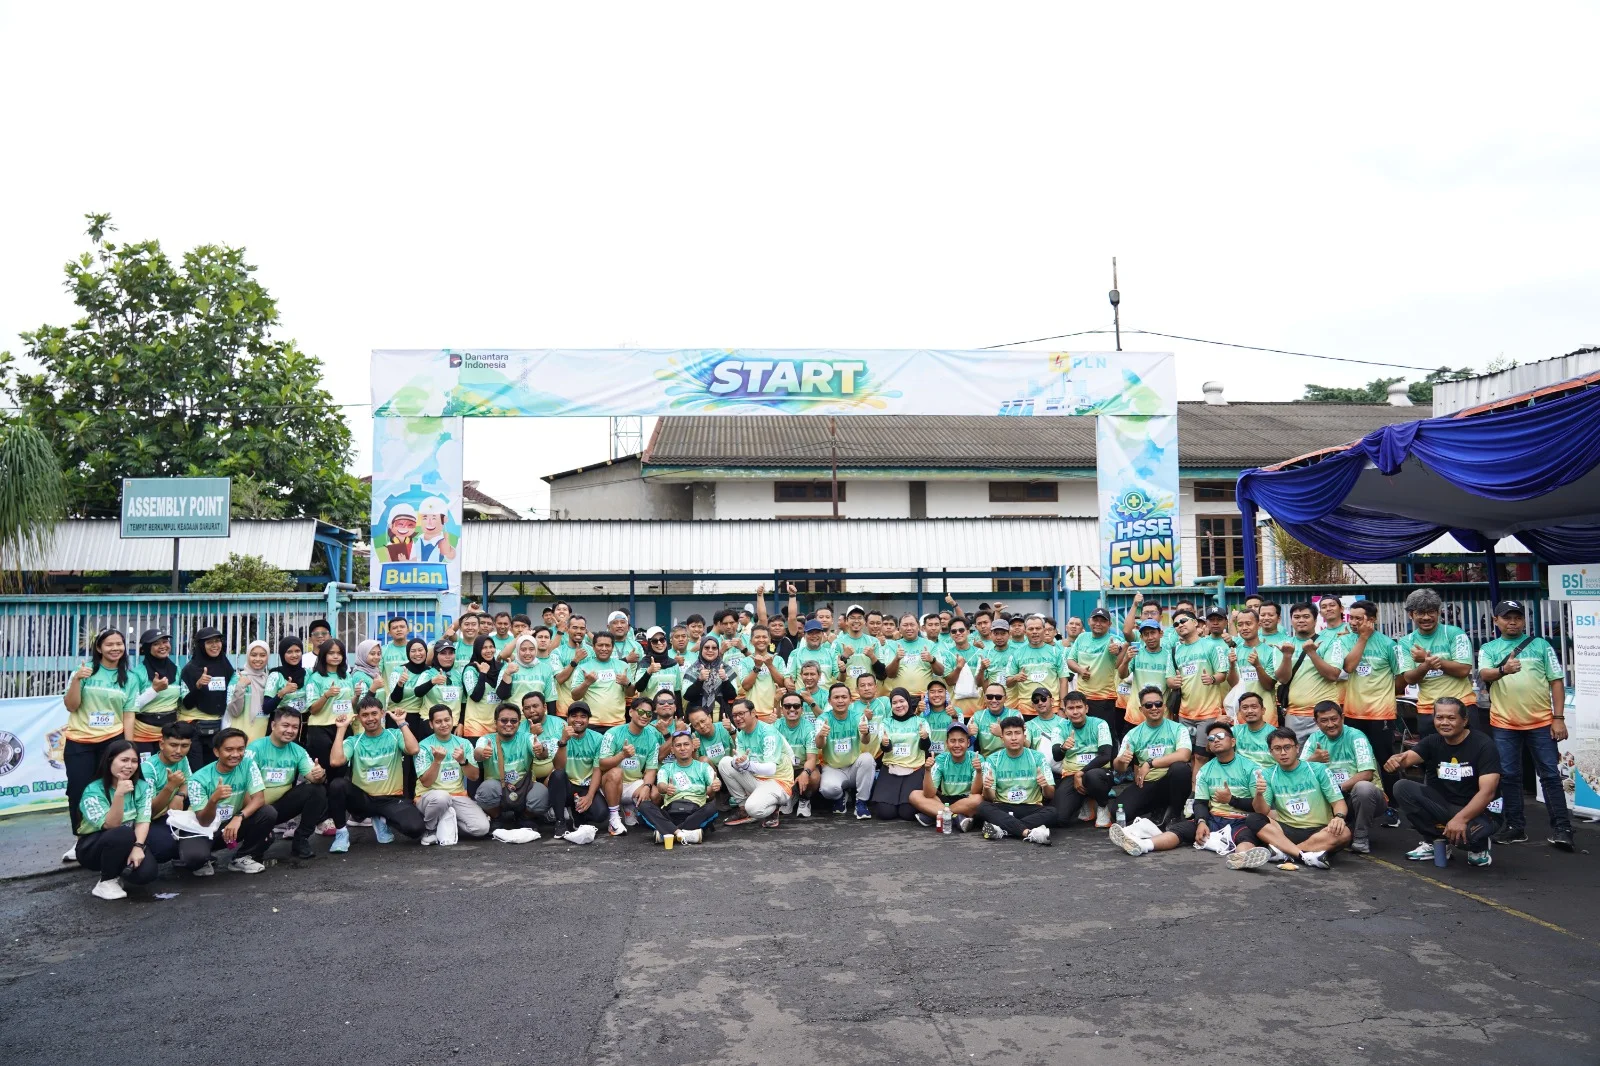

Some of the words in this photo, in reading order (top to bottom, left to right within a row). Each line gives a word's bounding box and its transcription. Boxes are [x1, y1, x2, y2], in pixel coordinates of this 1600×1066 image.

[464, 353, 509, 361] Danantara
[464, 361, 507, 369] Indonesia
[1073, 357, 1107, 369] PLN
[708, 360, 864, 394] START
[127, 496, 188, 518] ASSEMBLY
[189, 495, 224, 517] POINT
[1116, 518, 1173, 540] HSSE
[1111, 537, 1174, 566] FUN
[385, 567, 443, 585] Bulan
[1111, 562, 1174, 588] RUN
[1561, 573, 1583, 589] BSI
[1575, 615, 1596, 626] BSI
[32, 781, 68, 792] Kiner
